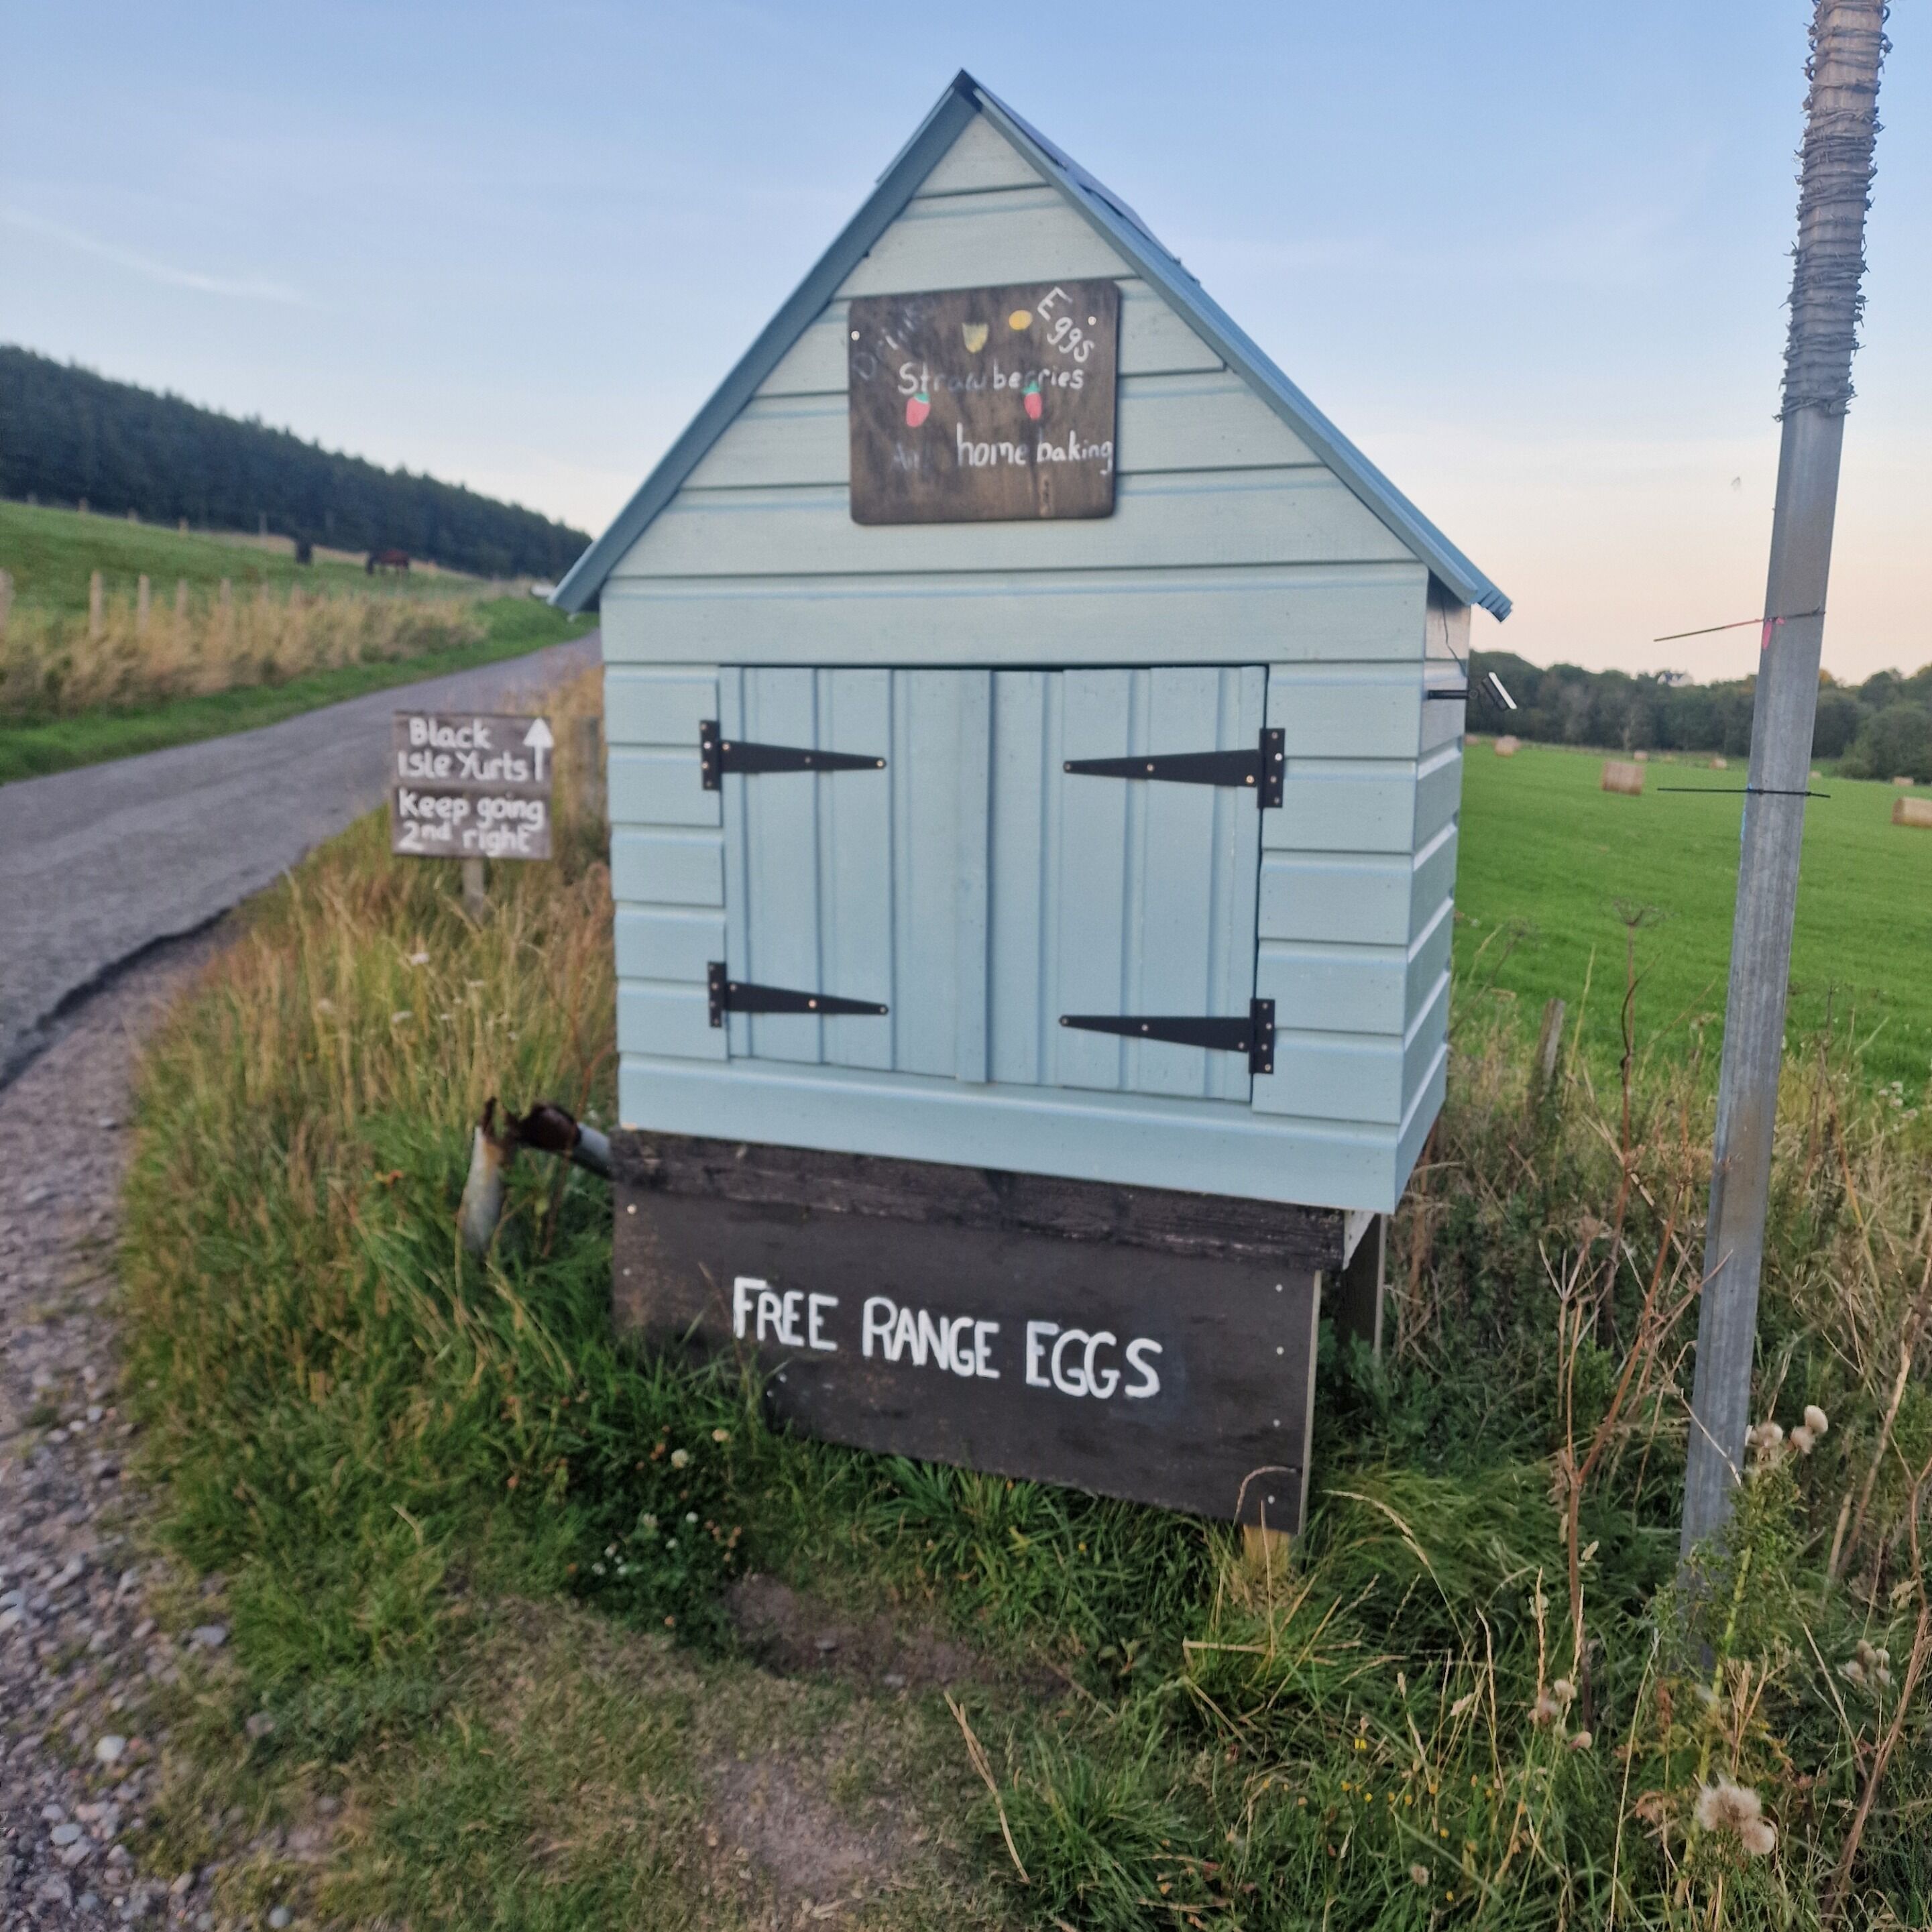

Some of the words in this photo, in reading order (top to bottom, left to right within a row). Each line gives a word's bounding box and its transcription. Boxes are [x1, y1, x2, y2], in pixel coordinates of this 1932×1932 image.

[1037, 286, 1095, 363] Eggs
[897, 358, 1085, 396] Strawberries
[956, 422, 1027, 467] home
[1036, 430, 1115, 475] baking
[409, 717, 492, 750] Black
[398, 749, 452, 779] Isle
[455, 750, 529, 782] Yurts
[398, 787, 469, 826] Keep
[476, 792, 545, 832] going
[398, 819, 453, 852] 2nd
[462, 822, 531, 857] right
[734, 1276, 838, 1351] FREE
[862, 1296, 1001, 1379] RANGE
[1026, 1320, 1163, 1400] EGGS
